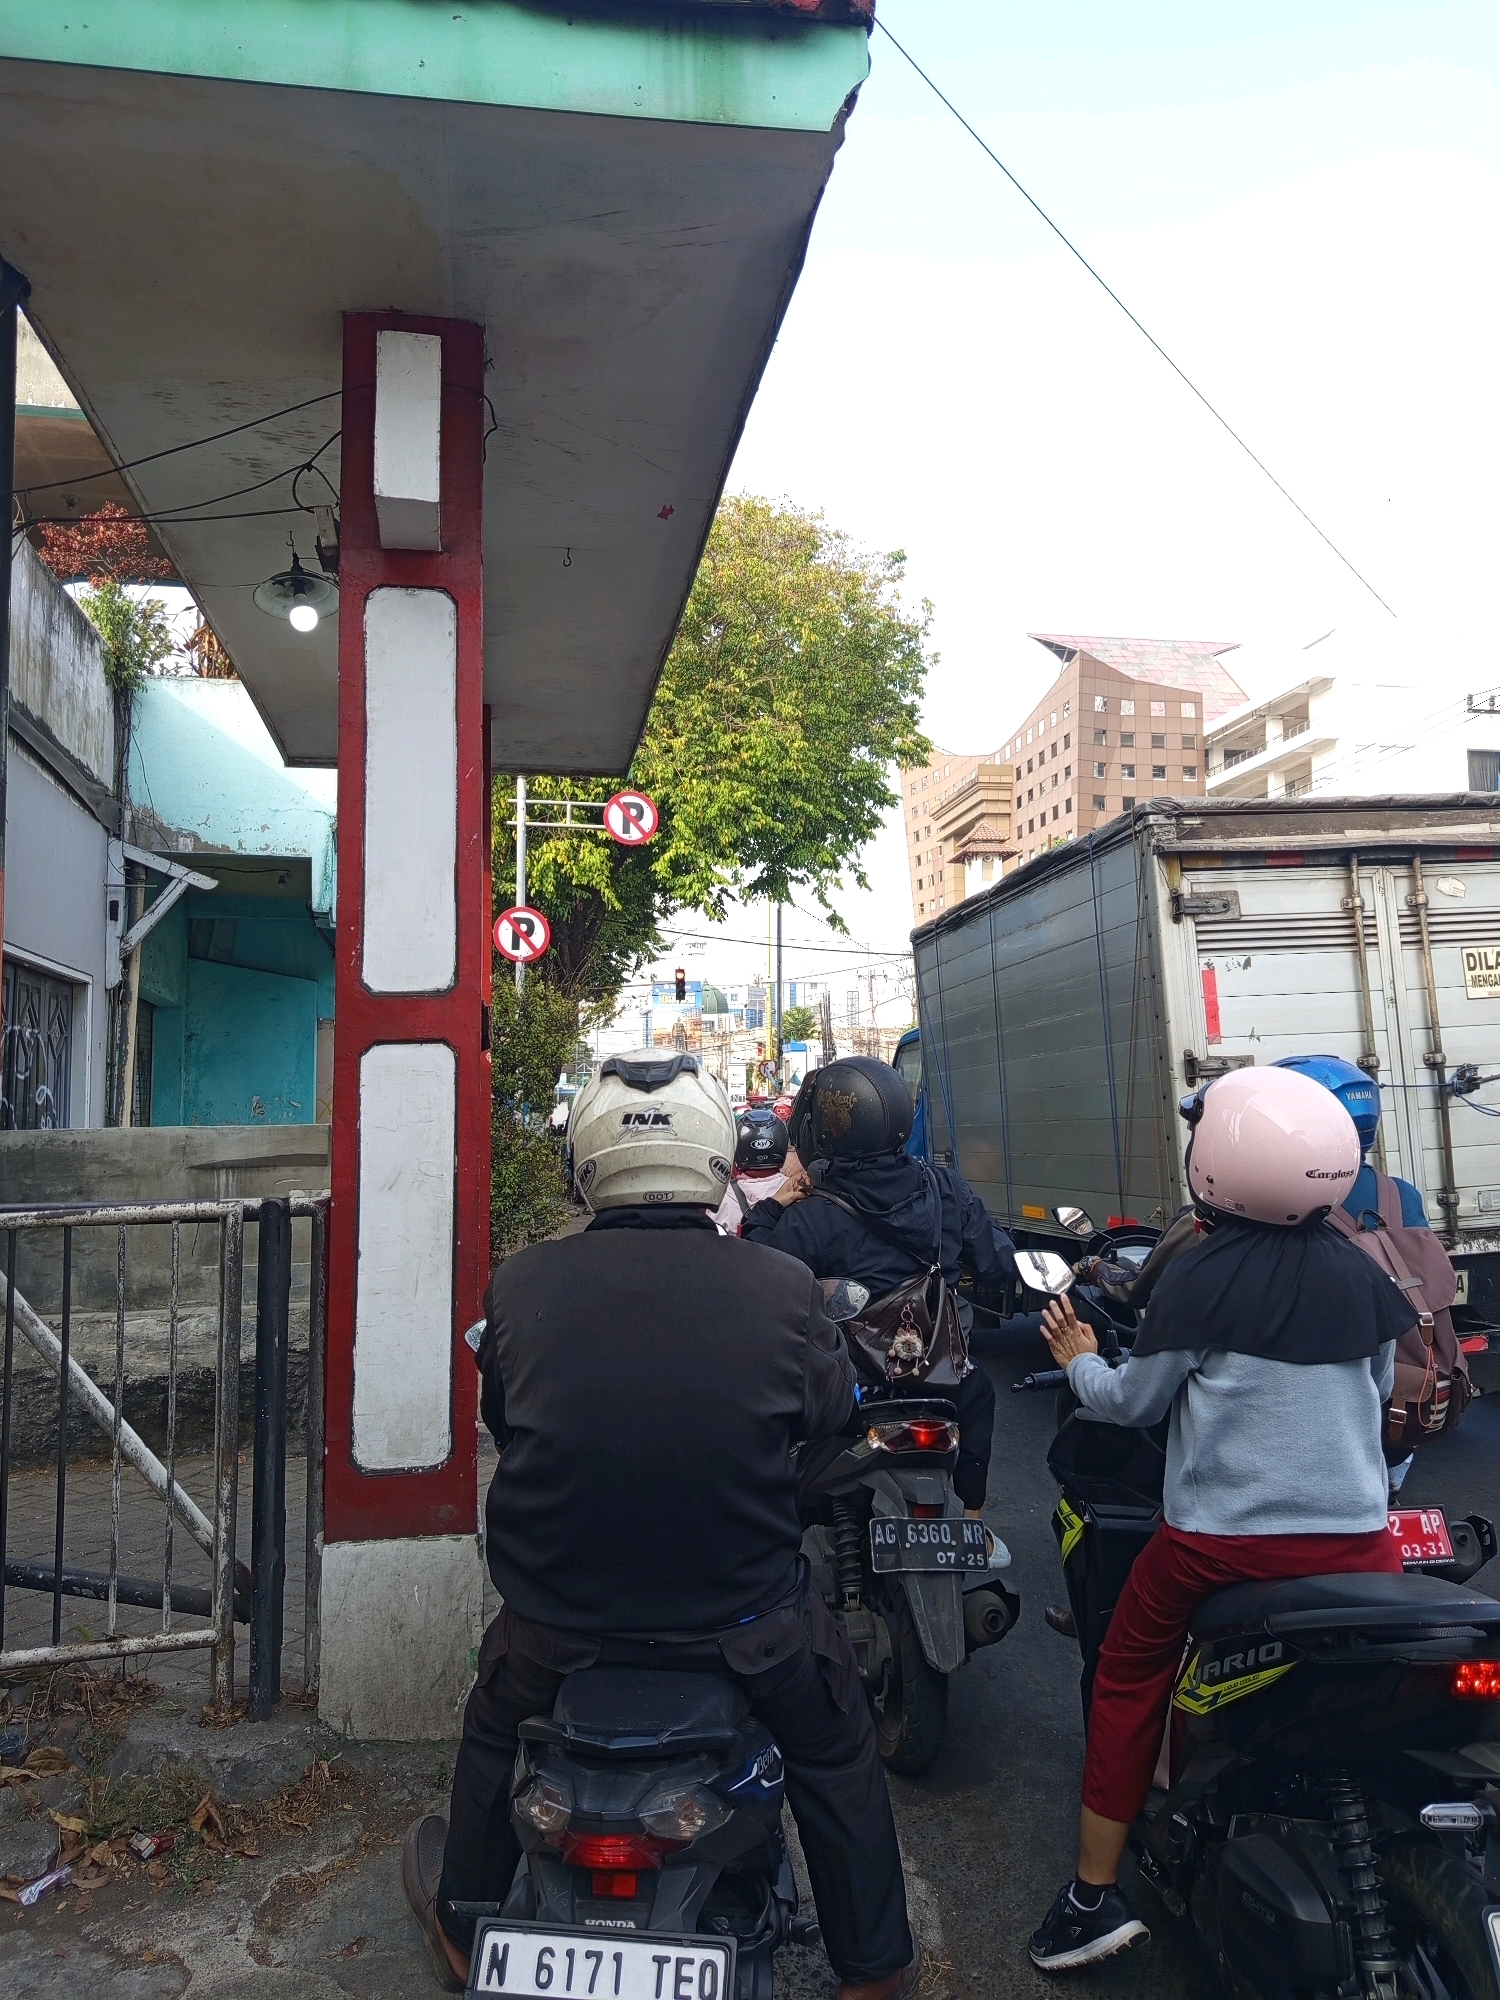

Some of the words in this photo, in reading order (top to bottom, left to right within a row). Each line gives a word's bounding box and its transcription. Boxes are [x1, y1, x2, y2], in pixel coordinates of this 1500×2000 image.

[622, 801, 644, 834] P
[511, 916, 536, 950] P
[1470, 973, 1500, 988] MENGA
[1345, 1090, 1373, 1101] YAMAHA
[621, 1113, 673, 1126] INK
[712, 1160, 731, 1178] INK
[1305, 1168, 1355, 1181] Cargloss
[649, 1193, 669, 1201] DOT
[1420, 1514, 1441, 1535] AP
[875, 1523, 896, 1546] AG
[907, 1523, 951, 1544] 6360
[962, 1523, 985, 1545] NR
[1187, 1641, 1283, 1690] VARIO
[584, 1919, 636, 1929] HONDA
[485, 1942, 510, 1987] N
[535, 1946, 624, 1996] 6171
